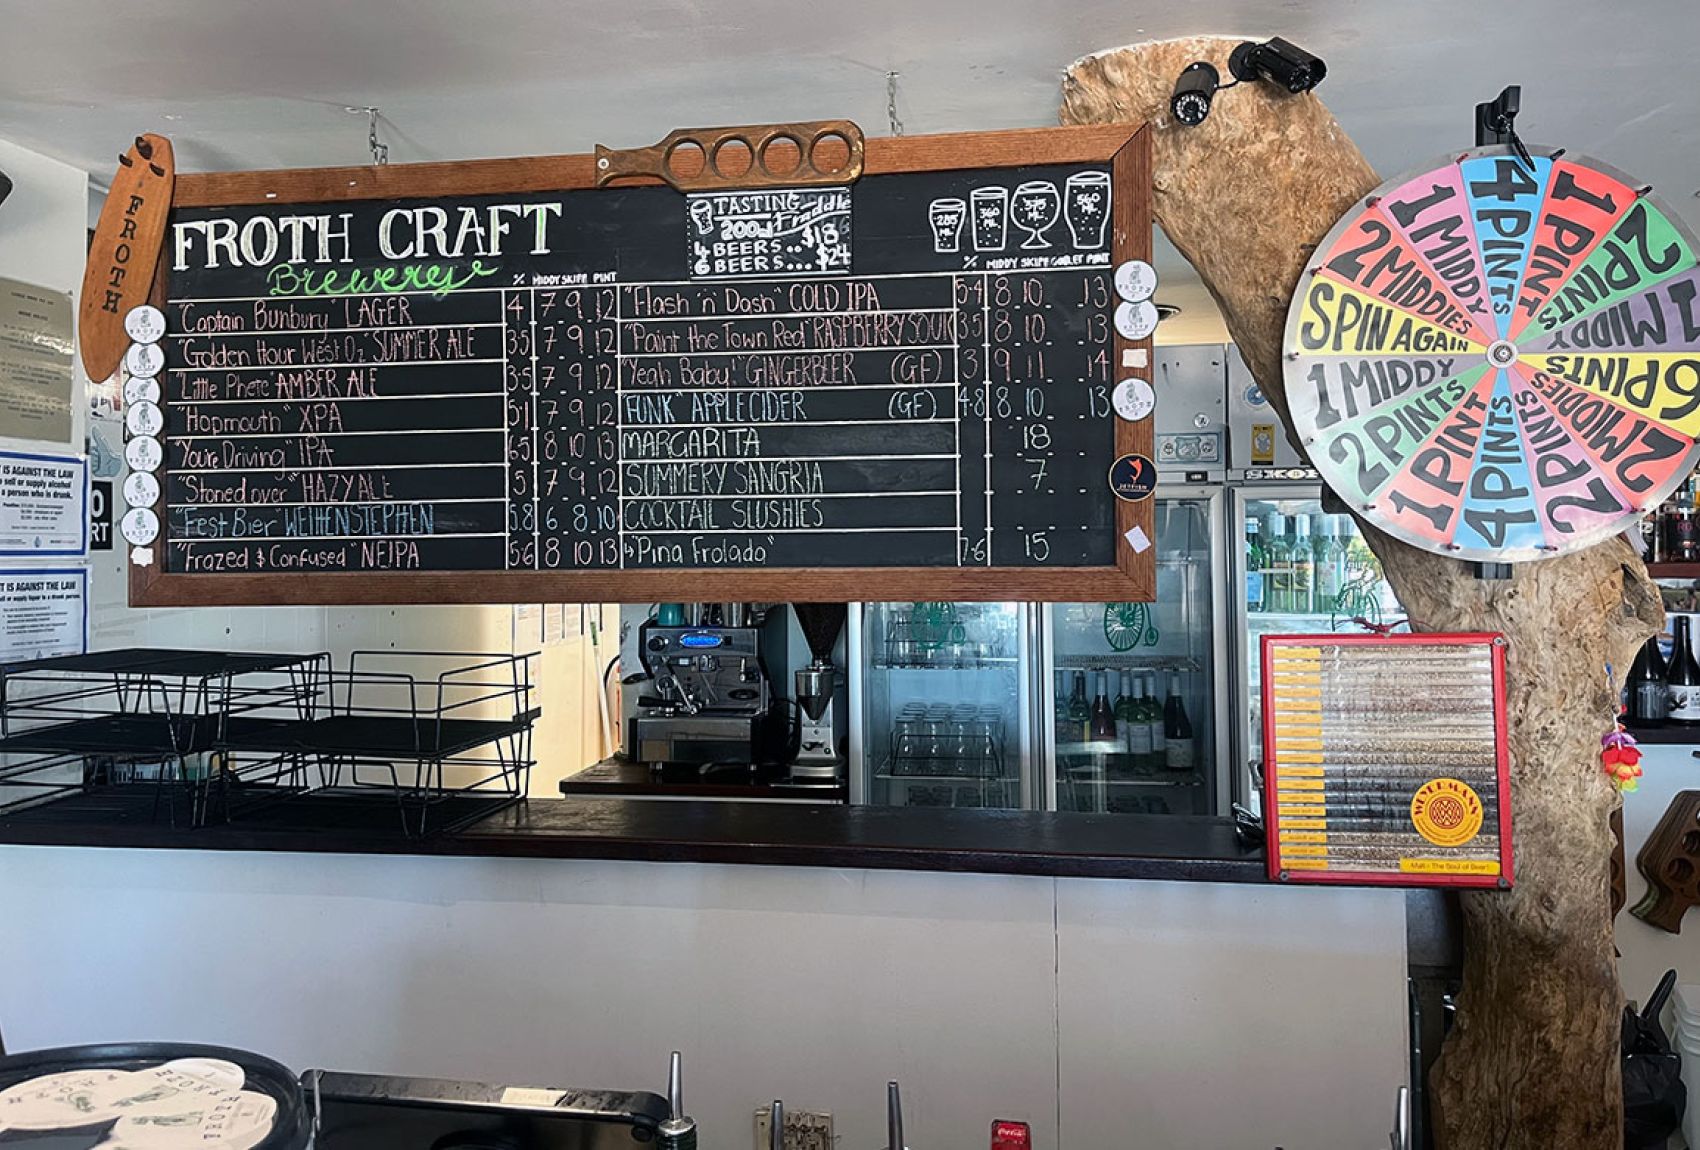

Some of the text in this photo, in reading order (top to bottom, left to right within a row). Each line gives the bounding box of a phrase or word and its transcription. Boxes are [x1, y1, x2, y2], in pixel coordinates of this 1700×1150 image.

[714, 192, 799, 215] TASTING
[101, 195, 145, 315] FROTH
[172, 203, 562, 271] FROTH CRAFT
[1388, 183, 1489, 317] 1 MIDDY
[1468, 158, 1539, 315] 4 PINTS
[1518, 170, 1617, 317] 1 PINT
[268, 261, 498, 299] Brewery
[694, 259, 710, 275] 6
[1325, 219, 1474, 337] 2 MIDDIES
[1538, 204, 1682, 332] 2 PINTS
[345, 296, 413, 328] LAGER
[507, 294, 524, 321] 4
[541, 292, 556, 317] 7
[565, 290, 583, 319] 9
[596, 289, 616, 322] 12
[790, 283, 839, 312] COLD
[846, 282, 880, 311] IPA
[995, 277, 1011, 306] 8
[1024, 278, 1043, 306] 10
[1084, 276, 1108, 308] 13
[688, 324, 718, 352] the
[722, 322, 768, 349] Town
[813, 312, 905, 349] RASPBERRY
[994, 309, 1011, 343] 8
[1025, 314, 1045, 344] 10
[1088, 314, 1108, 344] 13
[1300, 282, 1470, 354] SPIN AGAIN
[1550, 291, 1667, 349] MIDDY
[301, 338, 341, 364] West
[447, 328, 475, 358] ALE
[544, 326, 557, 352] 7
[567, 324, 583, 354] 9
[595, 328, 616, 355] 12
[275, 369, 341, 400] AMBER
[347, 368, 379, 397] ALE
[541, 367, 555, 389] 7
[569, 363, 582, 391] 9
[595, 363, 615, 390] 12
[891, 349, 942, 384] (GF)
[962, 349, 977, 379] 3
[994, 348, 1011, 382] 9
[1028, 351, 1043, 380] 11
[1088, 349, 1109, 381] 14
[693, 391, 745, 422] APPLE
[750, 391, 807, 422] CIDER
[996, 386, 1012, 418] 8
[1026, 388, 1044, 417] 10
[1089, 386, 1110, 417] 13
[1307, 357, 1456, 431] 1 MIDDY
[1546, 355, 1700, 421] 6 PINTS
[300, 402, 343, 432] XPA
[541, 400, 558, 426] 7
[569, 398, 584, 427] 9
[597, 401, 615, 425] 12
[1530, 370, 1687, 491] 2 MIDDIES
[300, 435, 335, 468] IPA
[544, 430, 558, 460] 8
[569, 432, 586, 458] 10
[597, 431, 614, 461] 13
[622, 424, 1051, 458] MARGARITA 18
[1328, 378, 1468, 498] 2 PINTS
[626, 459, 1048, 496] SUMMERY SANGRIA 7
[1388, 390, 1490, 533] 1 PINT
[1462, 395, 1537, 548] 4 PINTS
[1513, 389, 1625, 534] 2 PINTS
[302, 472, 354, 502] HAZY
[358, 472, 394, 500] ALE
[513, 470, 526, 495] 5
[544, 469, 558, 496] 7
[569, 466, 586, 496] 9
[598, 468, 618, 494] 12
[546, 505, 558, 530] 6
[573, 504, 588, 532] 8
[597, 504, 616, 531] 10
[624, 499, 824, 530] COCKTAIL SLUSHIES
[545, 538, 561, 568] 8
[574, 541, 593, 566] 10
[600, 538, 618, 565] 13
[1026, 532, 1049, 561] 15
